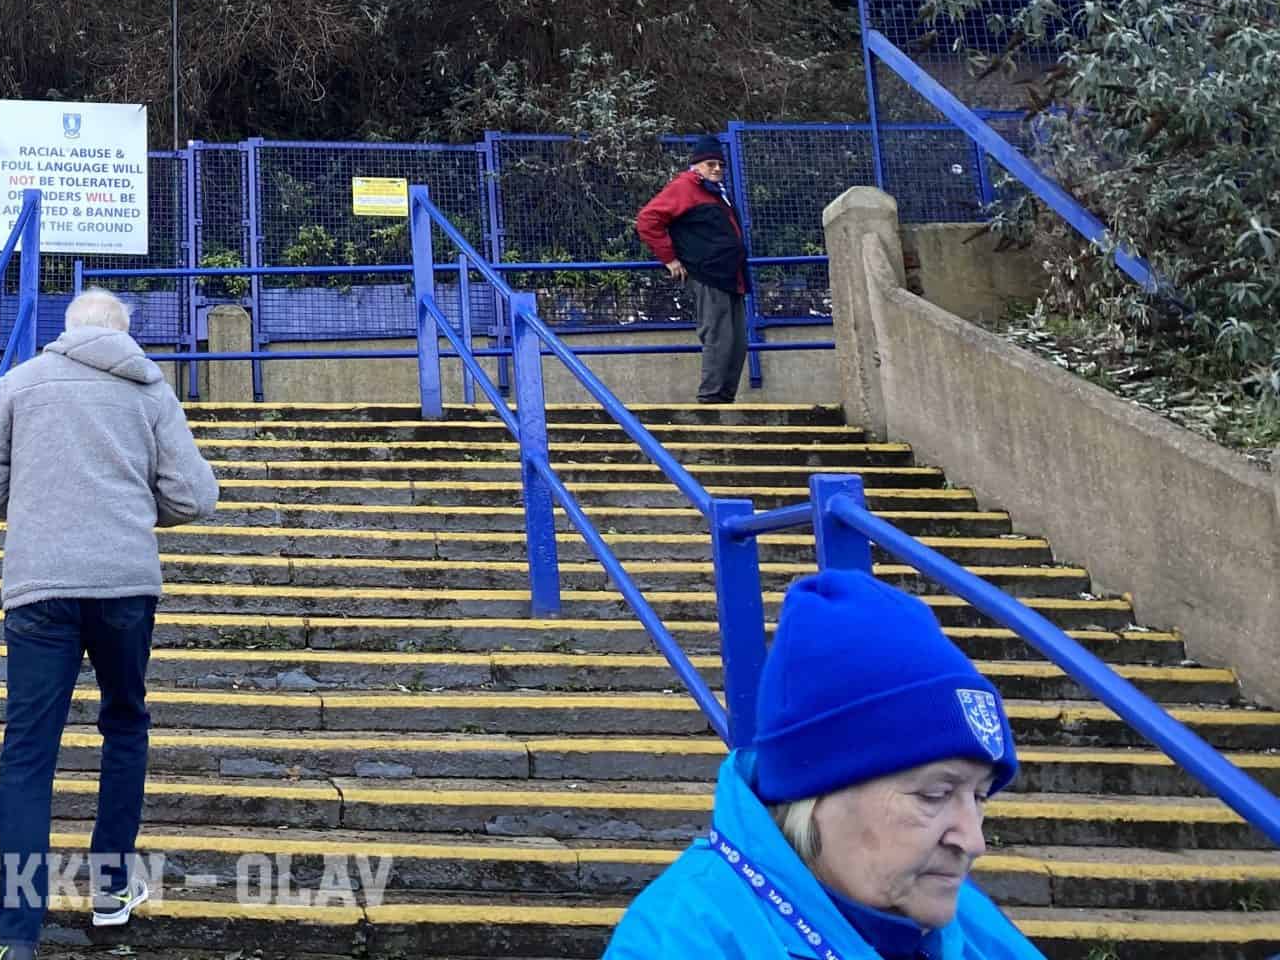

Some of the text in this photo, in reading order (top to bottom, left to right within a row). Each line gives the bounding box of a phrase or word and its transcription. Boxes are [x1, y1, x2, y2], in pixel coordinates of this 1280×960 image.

[19, 146, 125, 159] RACIAL ABUSE &
[1, 160, 144, 174] FOUL LANGUAGE WILL
[9, 175, 135, 190] NOT BE TOLERATED,
[7, 190, 136, 203] OFNDERS WILL BE
[72, 206, 82, 217] &
[86, 207, 140, 218] BANNED
[50, 221, 72, 232] THE
[77, 222, 133, 233] GROUND
